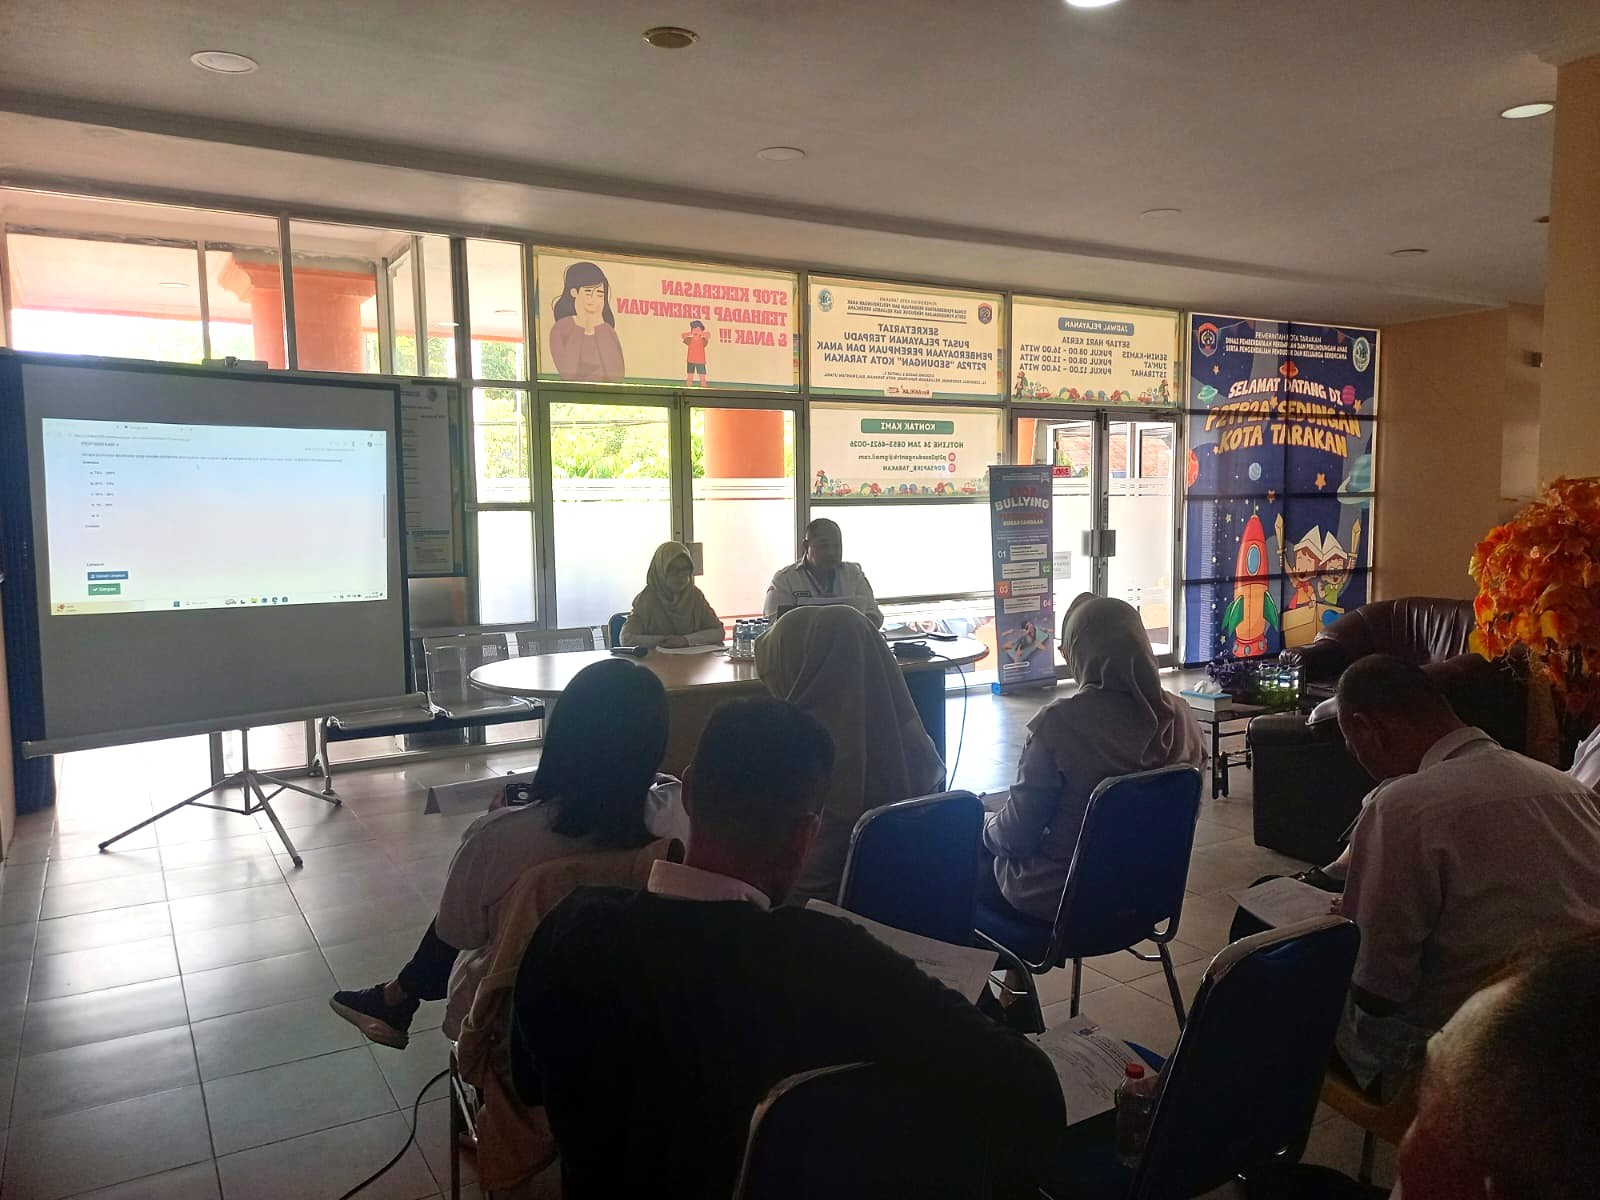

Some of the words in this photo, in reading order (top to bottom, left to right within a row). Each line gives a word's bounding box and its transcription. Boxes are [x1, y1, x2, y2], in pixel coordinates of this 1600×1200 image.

[1228, 378, 1281, 399] SELAMAT
[1284, 378, 1327, 399] DATANG
[1329, 387, 1343, 405] DI
[1277, 400, 1361, 437] SEDUNGAN
[1217, 425, 1263, 455] KOTA
[1271, 424, 1347, 458] TARAKAN
[995, 497, 1049, 511] BULLYING
